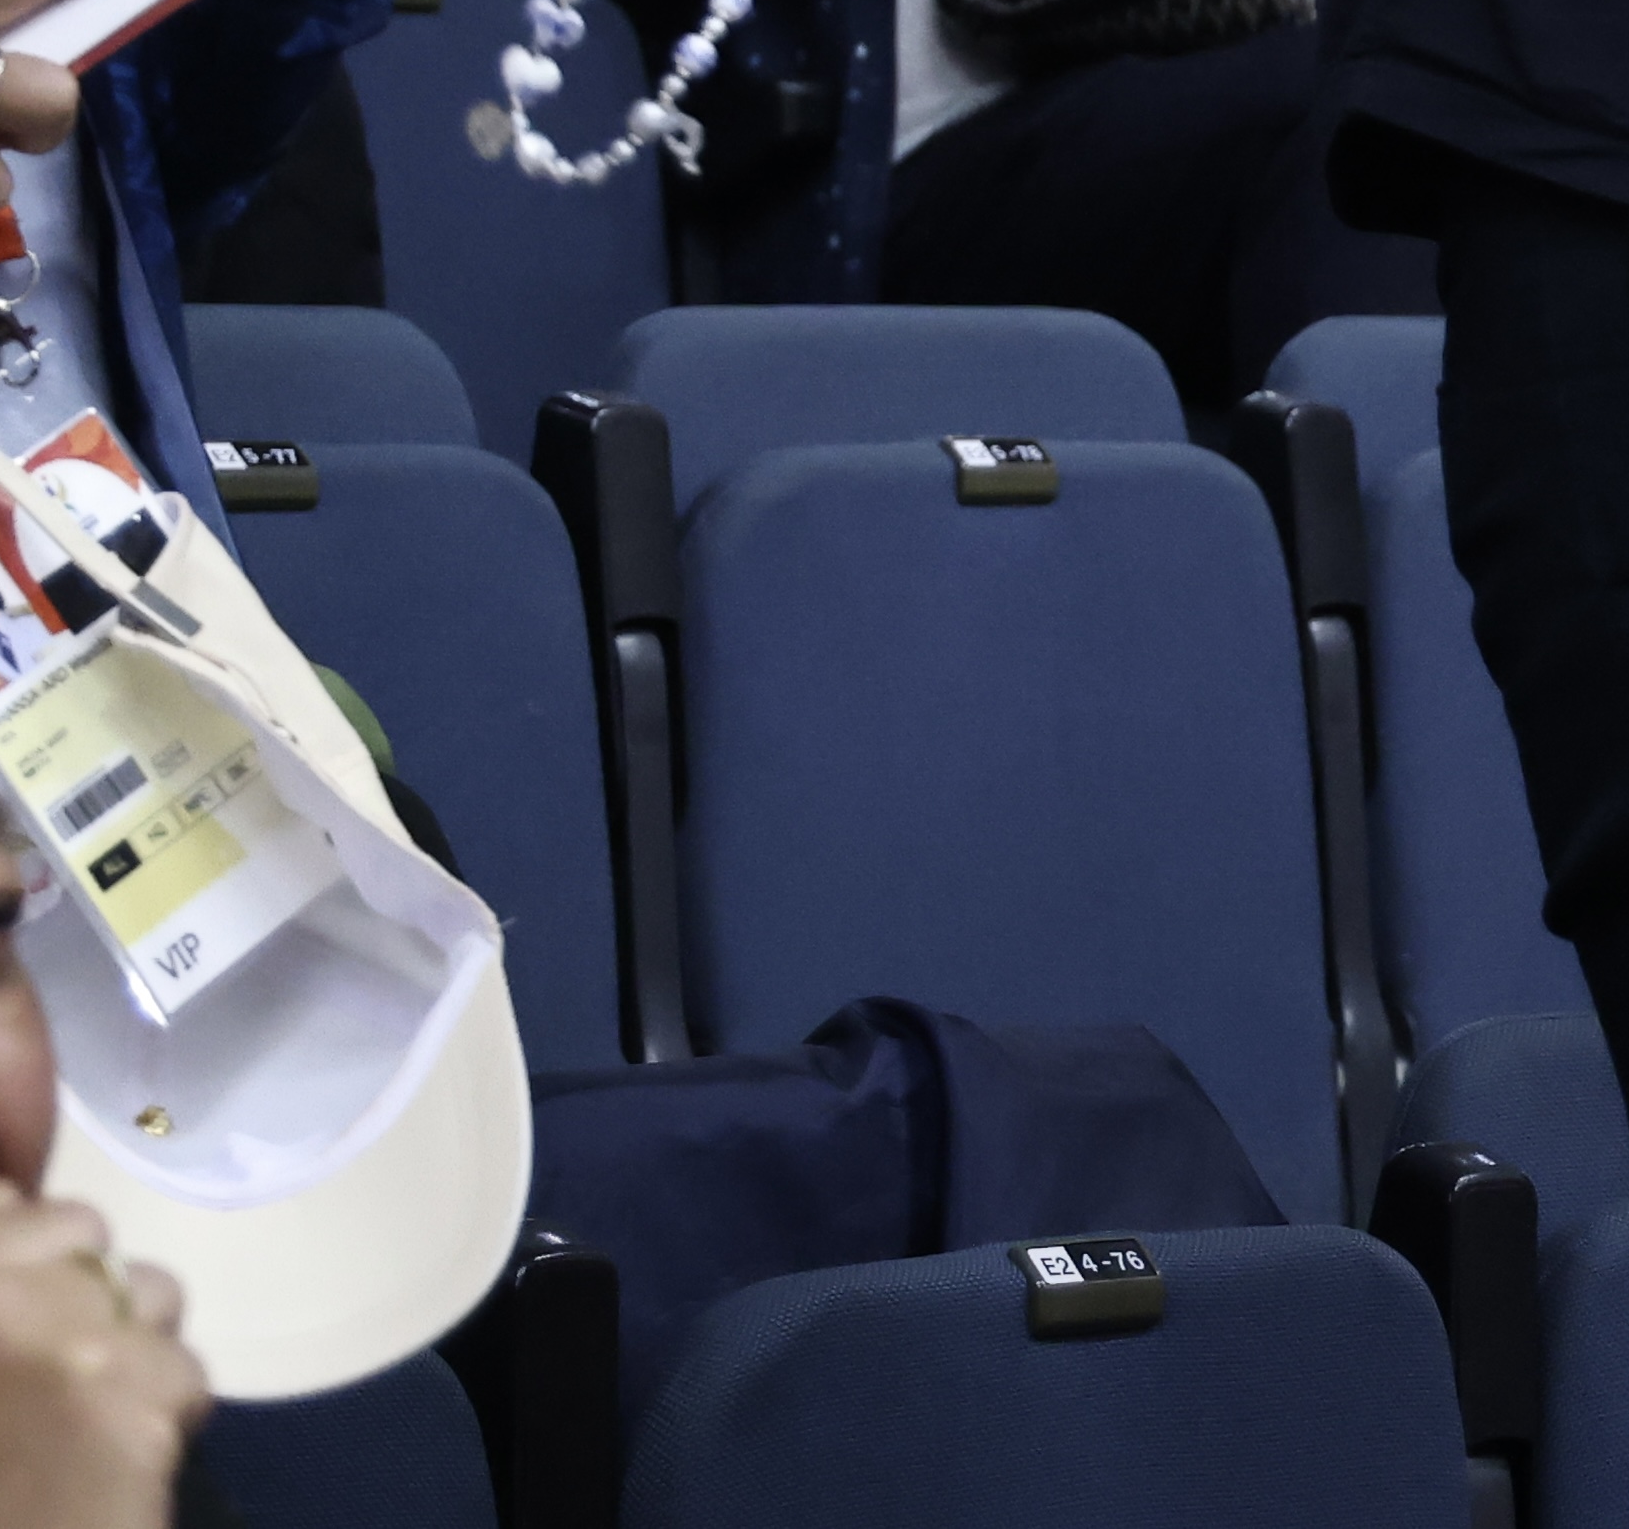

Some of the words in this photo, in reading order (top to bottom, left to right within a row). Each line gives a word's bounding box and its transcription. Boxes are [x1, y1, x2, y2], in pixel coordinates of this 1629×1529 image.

[153, 933, 199, 978] VIP
[1041, 1257, 1075, 1276] E2
[1082, 1250, 1145, 1273] 4-76
